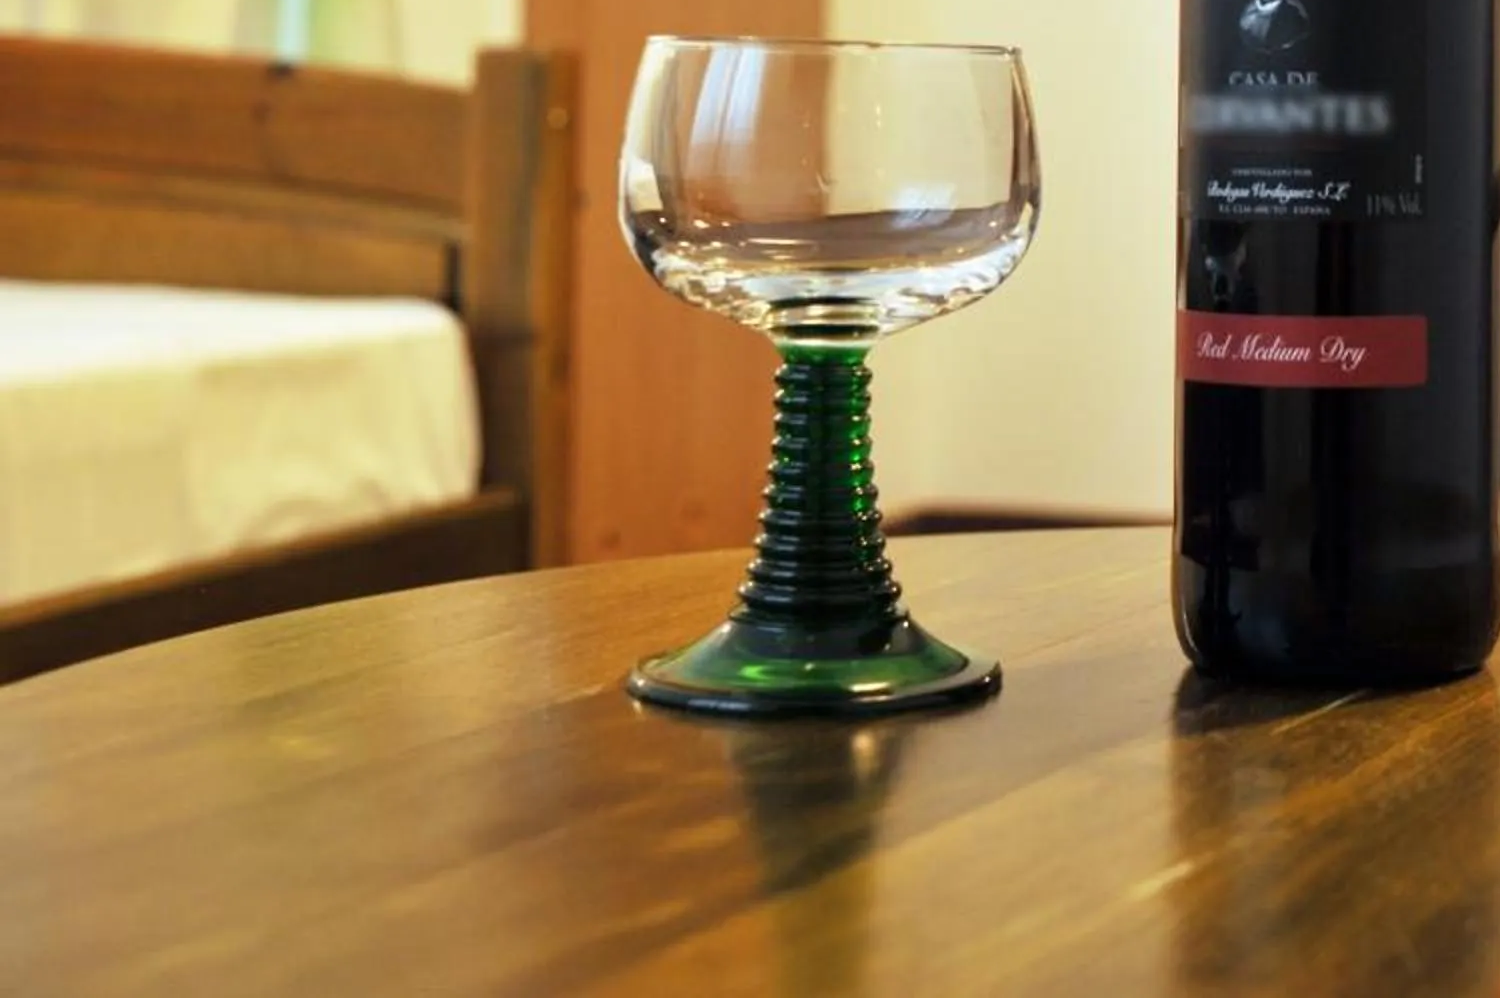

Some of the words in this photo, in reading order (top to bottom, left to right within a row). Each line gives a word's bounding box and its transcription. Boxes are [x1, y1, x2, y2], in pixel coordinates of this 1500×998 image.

[1228, 70, 1278, 86] CASA
[1197, 331, 1232, 359] Red
[1232, 333, 1310, 362] Medium
[1319, 335, 1367, 371] Dry
